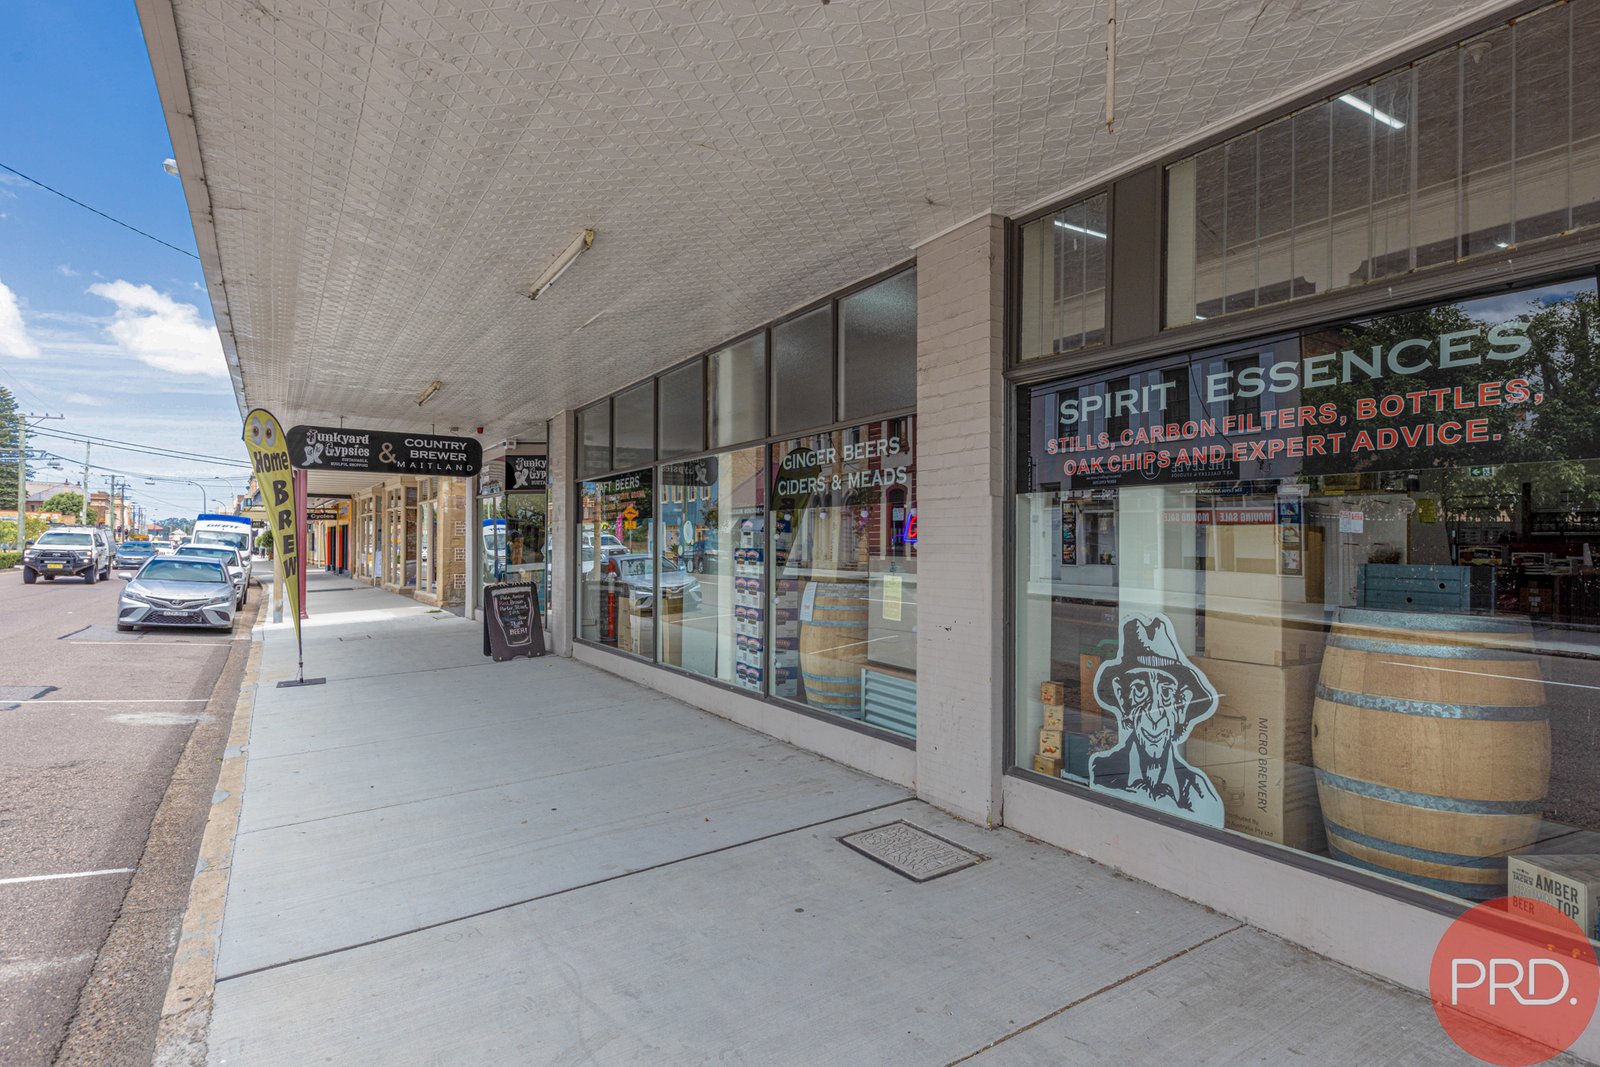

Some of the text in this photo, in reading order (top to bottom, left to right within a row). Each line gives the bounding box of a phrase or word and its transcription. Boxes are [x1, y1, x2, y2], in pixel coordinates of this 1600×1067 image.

[1060, 321, 1532, 424] SPIRIT ESSENCES
[1047, 378, 1544, 454] STILLS, CARBON FILTERS, BOTTLES,
[306, 429, 369, 445] Junkyard
[404, 438, 468, 451] COUNTRY
[1064, 418, 1501, 475] OAK CHIPS AND EXPERT ADVICE.
[325, 442, 370, 457] Gypsies
[379, 442, 397, 464] &
[410, 450, 467, 462] BREWER
[782, 436, 900, 470] GINGER BEERS
[253, 451, 289, 474] Home
[396, 460, 473, 472] MAITLAND
[593, 475, 640, 493] RAFT BEERS
[777, 466, 907, 496] CIDERS & MEADS
[1257, 717, 1268, 813] MICRO BREWERY
[1535, 874, 1579, 905] AMBER
[1512, 895, 1535, 915] BEER
[1556, 898, 1580, 919] TOP
